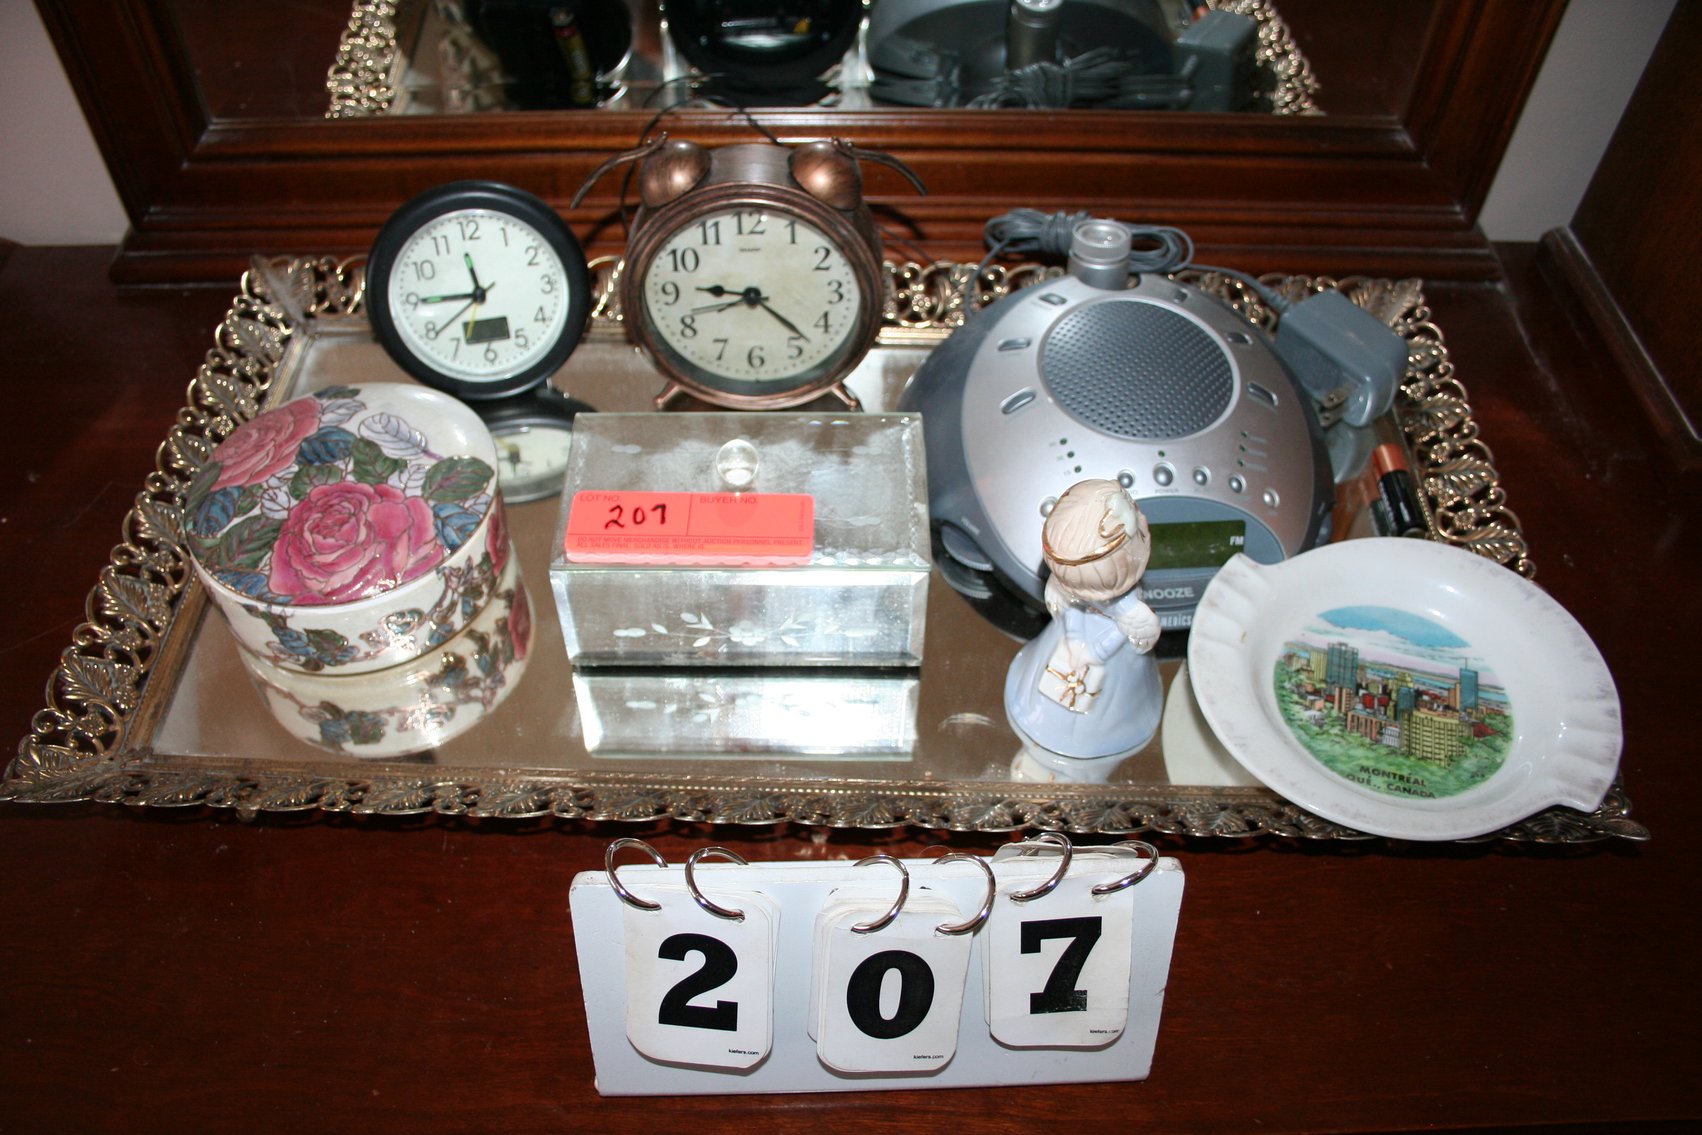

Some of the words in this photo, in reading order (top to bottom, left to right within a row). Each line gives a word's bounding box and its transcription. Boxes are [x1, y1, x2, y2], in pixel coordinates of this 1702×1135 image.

[458, 219, 481, 242] 12
[698, 219, 722, 246] 11
[731, 209, 766, 236] 12
[784, 219, 798, 245] 1
[432, 234, 450, 256] 11
[500, 227, 509, 247] 1
[525, 246, 540, 267] 2
[667, 246, 700, 273] 10
[812, 246, 832, 272] 2
[412, 259, 436, 281] 10
[540, 274, 554, 295] 3
[661, 281, 680, 306] 9
[827, 279, 844, 305] 3
[406, 291, 419, 311] 9
[533, 306, 548, 324] 4
[680, 313, 698, 339] 8
[813, 311, 831, 334] 4
[424, 321, 438, 341] 8
[515, 328, 529, 348] 5
[450, 337, 462, 360] 7
[484, 341, 498, 364] 6
[713, 338, 729, 361] 7
[747, 345, 765, 369] 6
[787, 336, 804, 360] 5
[579, 494, 600, 502] LOT
[700, 495, 738, 504] BUYER
[1229, 536, 1245, 546] FM
[1142, 586, 1195, 600] NOOZE
[1359, 765, 1427, 787] MONTRÉAL
[1386, 783, 1436, 799] CANADA
[657, 932, 739, 1032] 2
[846, 949, 935, 1040] 0
[1020, 915, 1103, 1015] 7
